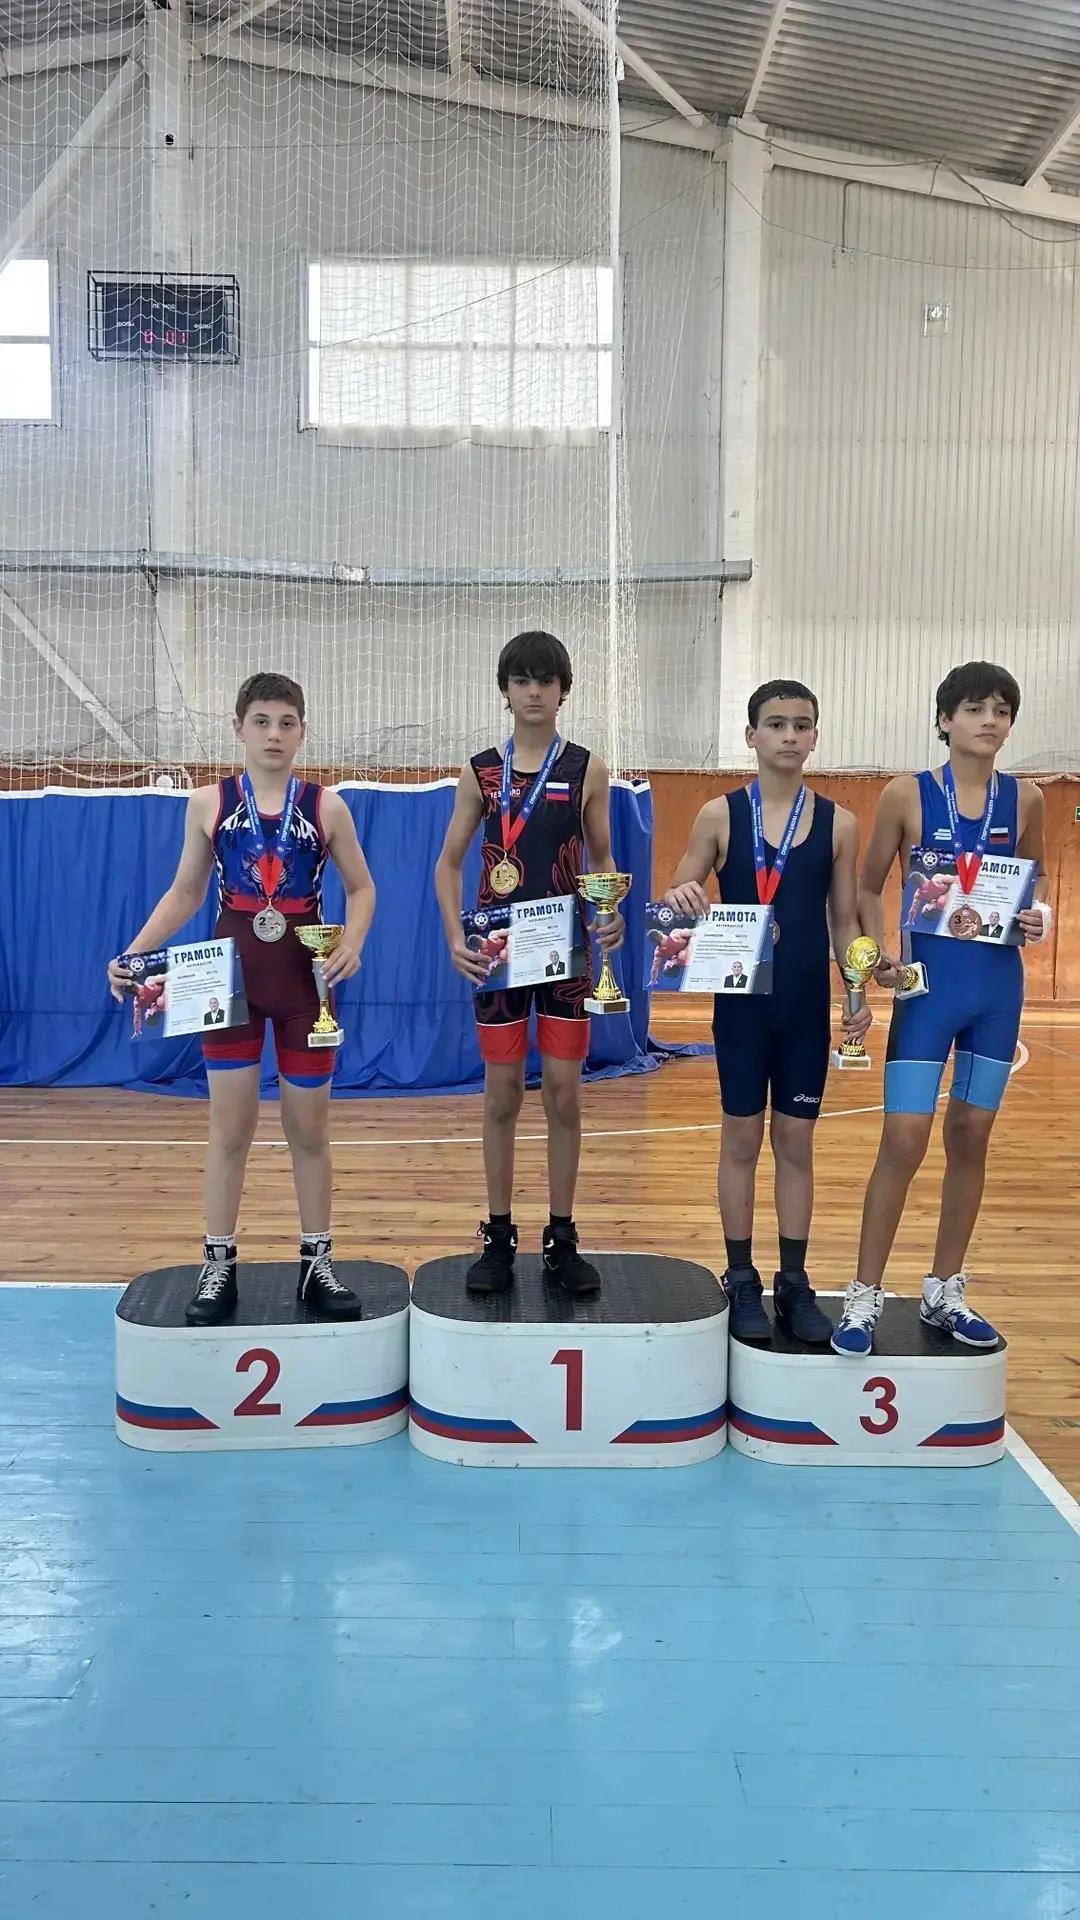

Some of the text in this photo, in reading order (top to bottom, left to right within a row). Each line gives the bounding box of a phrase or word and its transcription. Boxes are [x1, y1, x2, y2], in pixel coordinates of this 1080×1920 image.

[980, 861, 1021, 876] АМОТА
[516, 902, 564, 919] ГРАМОТА
[258, 916, 266, 926] 2
[954, 915, 962, 925] 3
[174, 946, 224, 964] ГРАМОТА
[233, 1347, 282, 1417] 2
[549, 1349, 583, 1432] 1
[859, 1376, 899, 1435] 3
